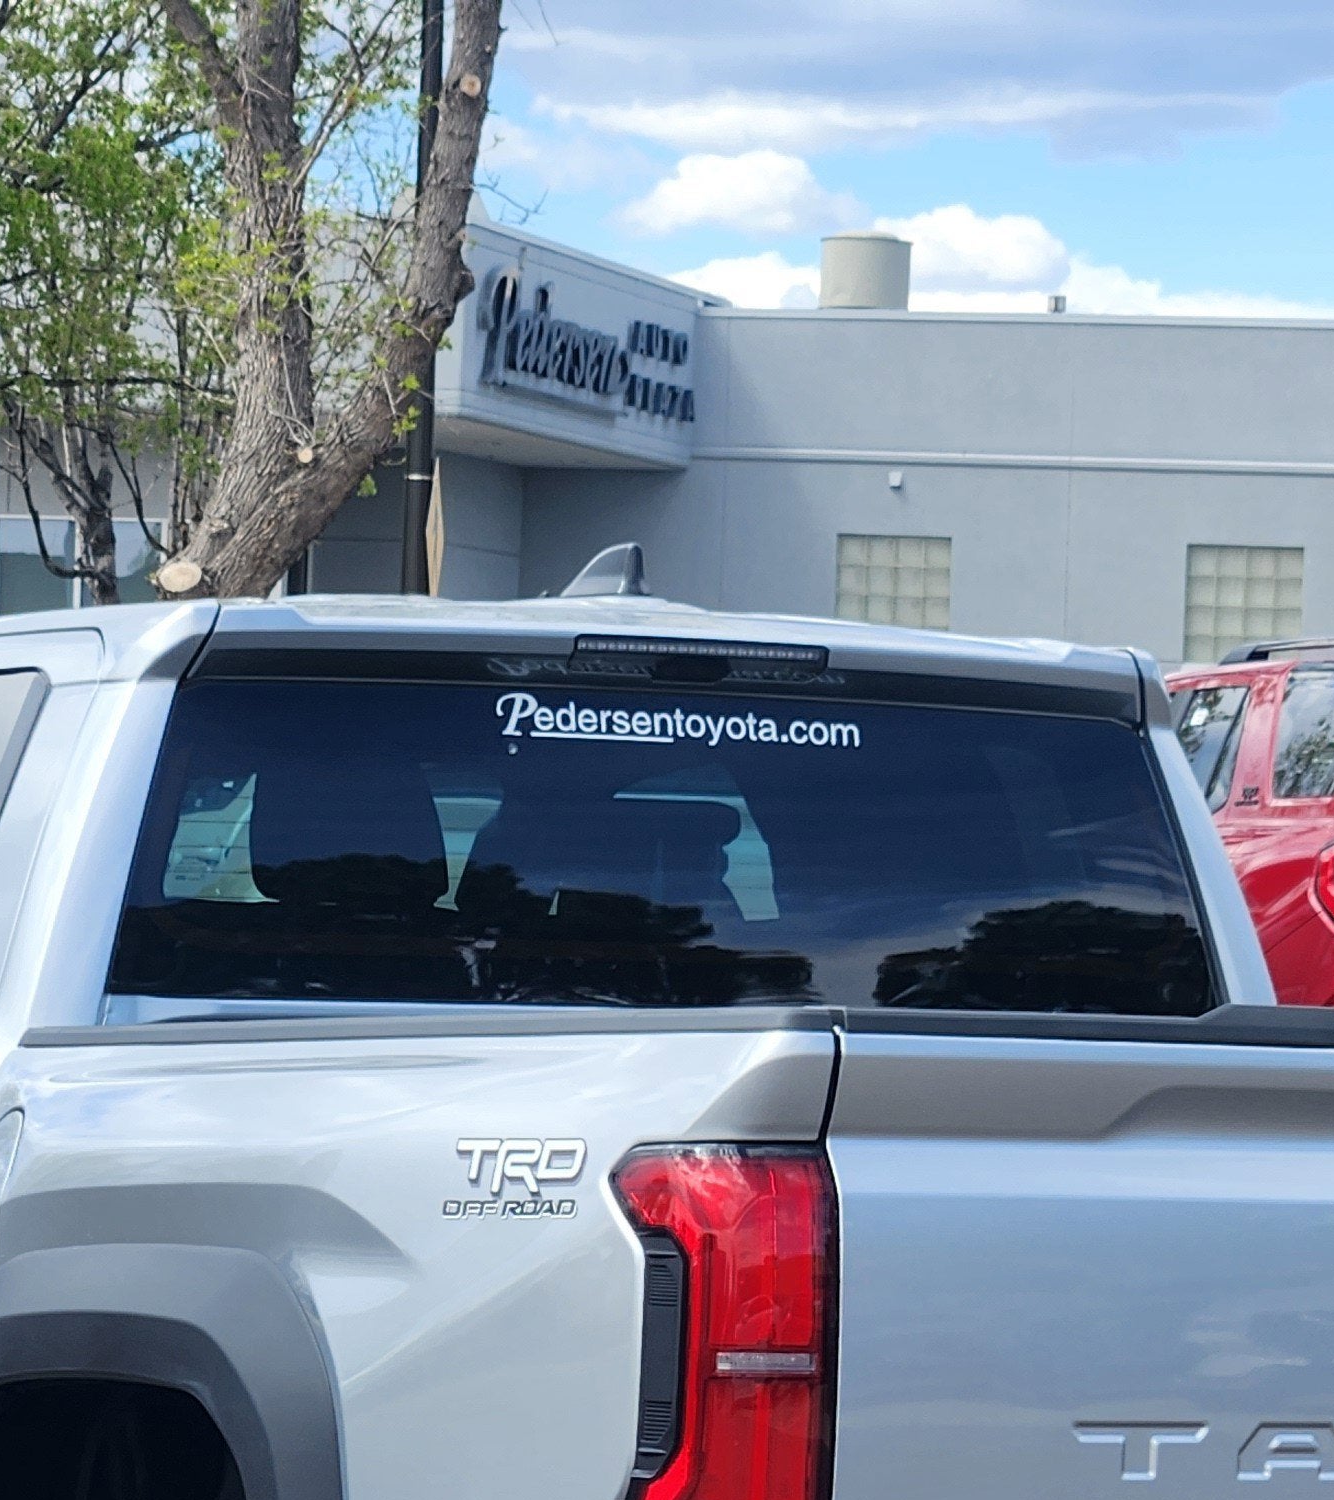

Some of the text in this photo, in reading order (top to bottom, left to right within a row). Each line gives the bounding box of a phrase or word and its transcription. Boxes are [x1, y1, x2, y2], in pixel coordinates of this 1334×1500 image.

[477, 262, 629, 396] Pedersen
[496, 693, 861, 747] Pedersentoyota.com
[456, 1138, 587, 1197] TRD
